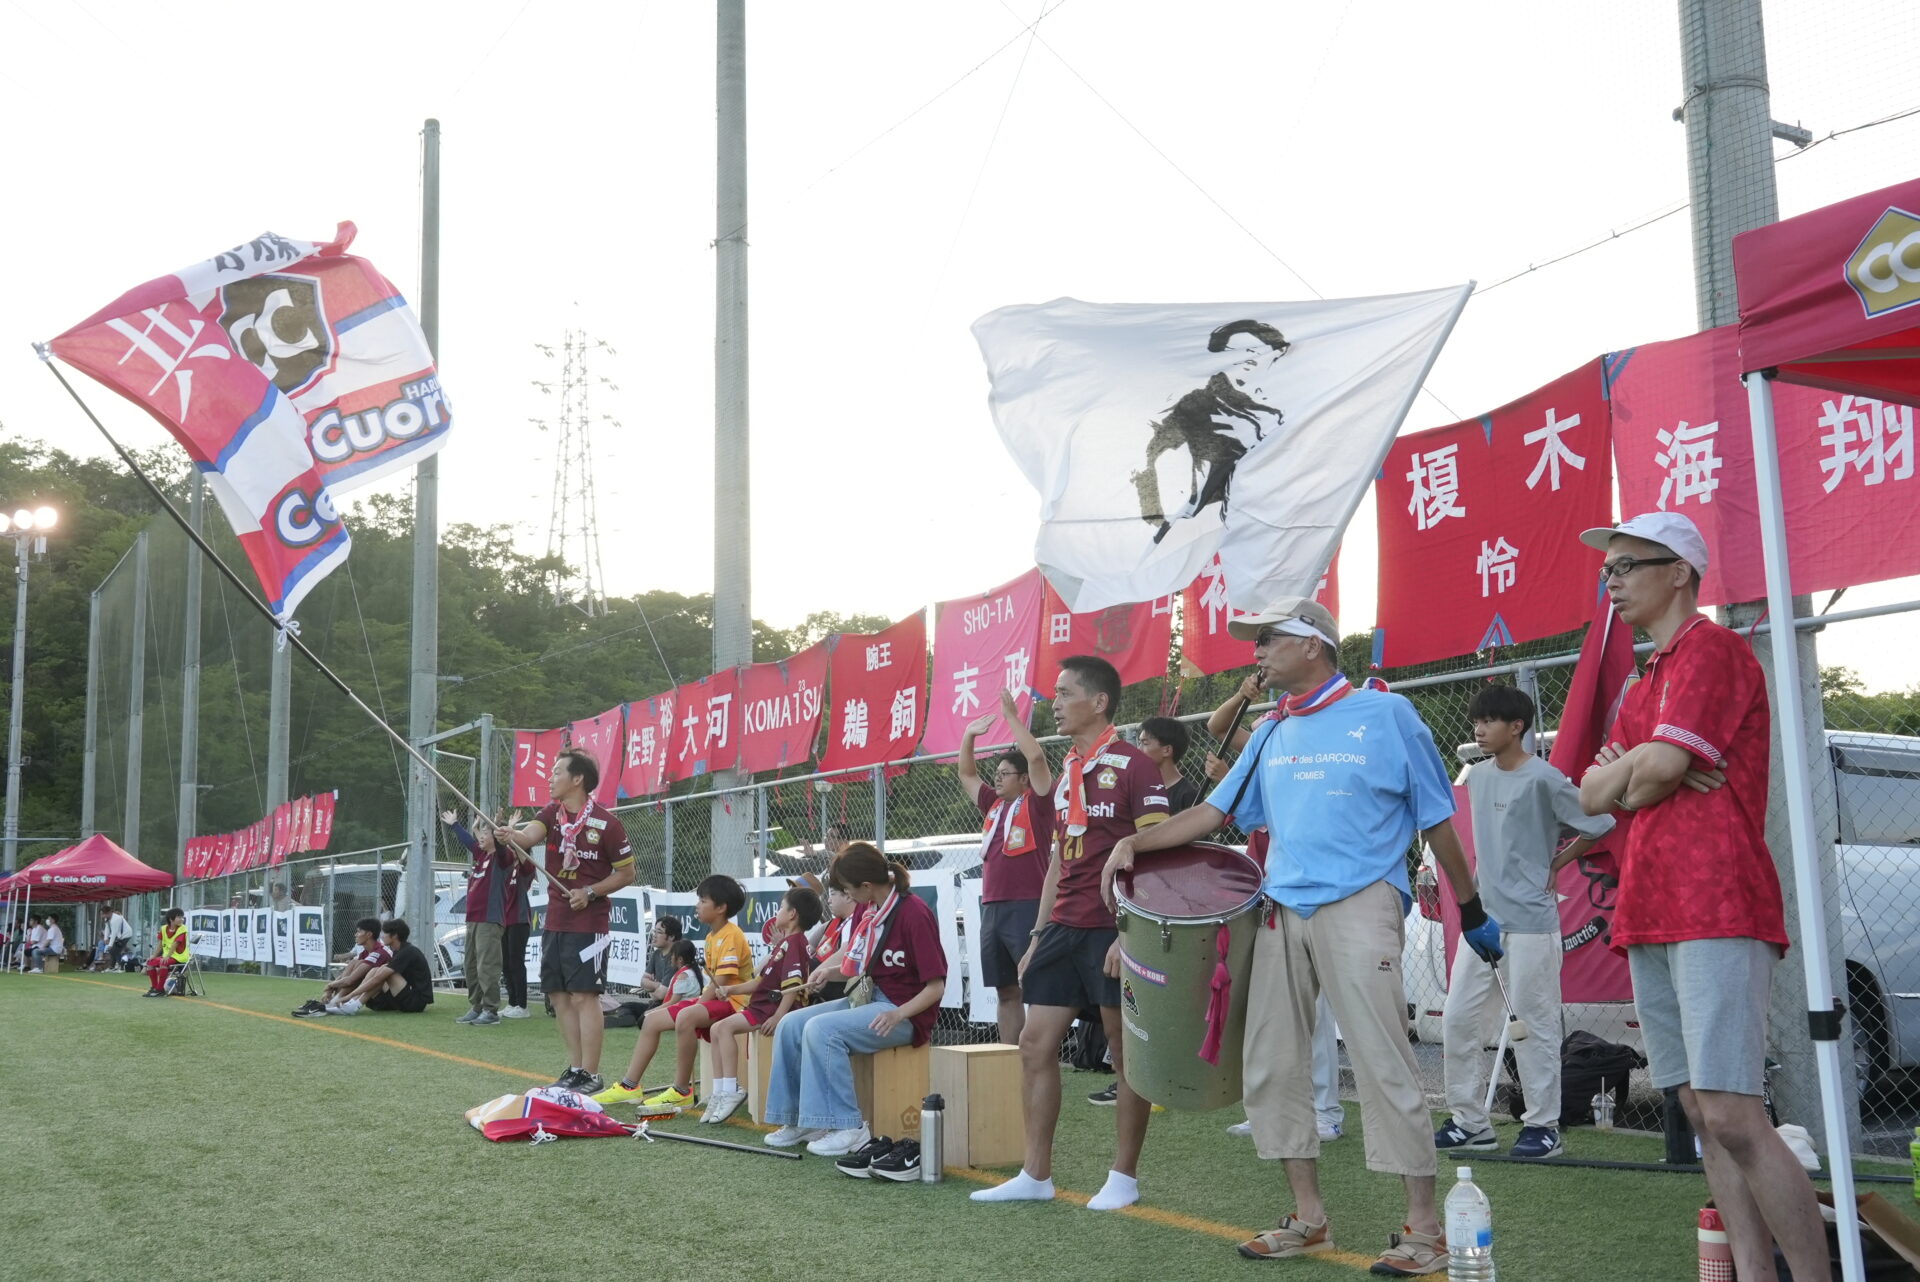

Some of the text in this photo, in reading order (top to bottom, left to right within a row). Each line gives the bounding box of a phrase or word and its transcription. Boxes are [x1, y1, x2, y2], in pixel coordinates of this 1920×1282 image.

[1476, 536, 1519, 598] 怜
[679, 692, 732, 762] 大河
[744, 684, 823, 735] KOMATSU
[627, 726, 656, 768] 佐野
[1314, 753, 1367, 766] GARÇONS
[608, 936, 640, 963] 友銀行
[882, 949, 906, 967] CC
